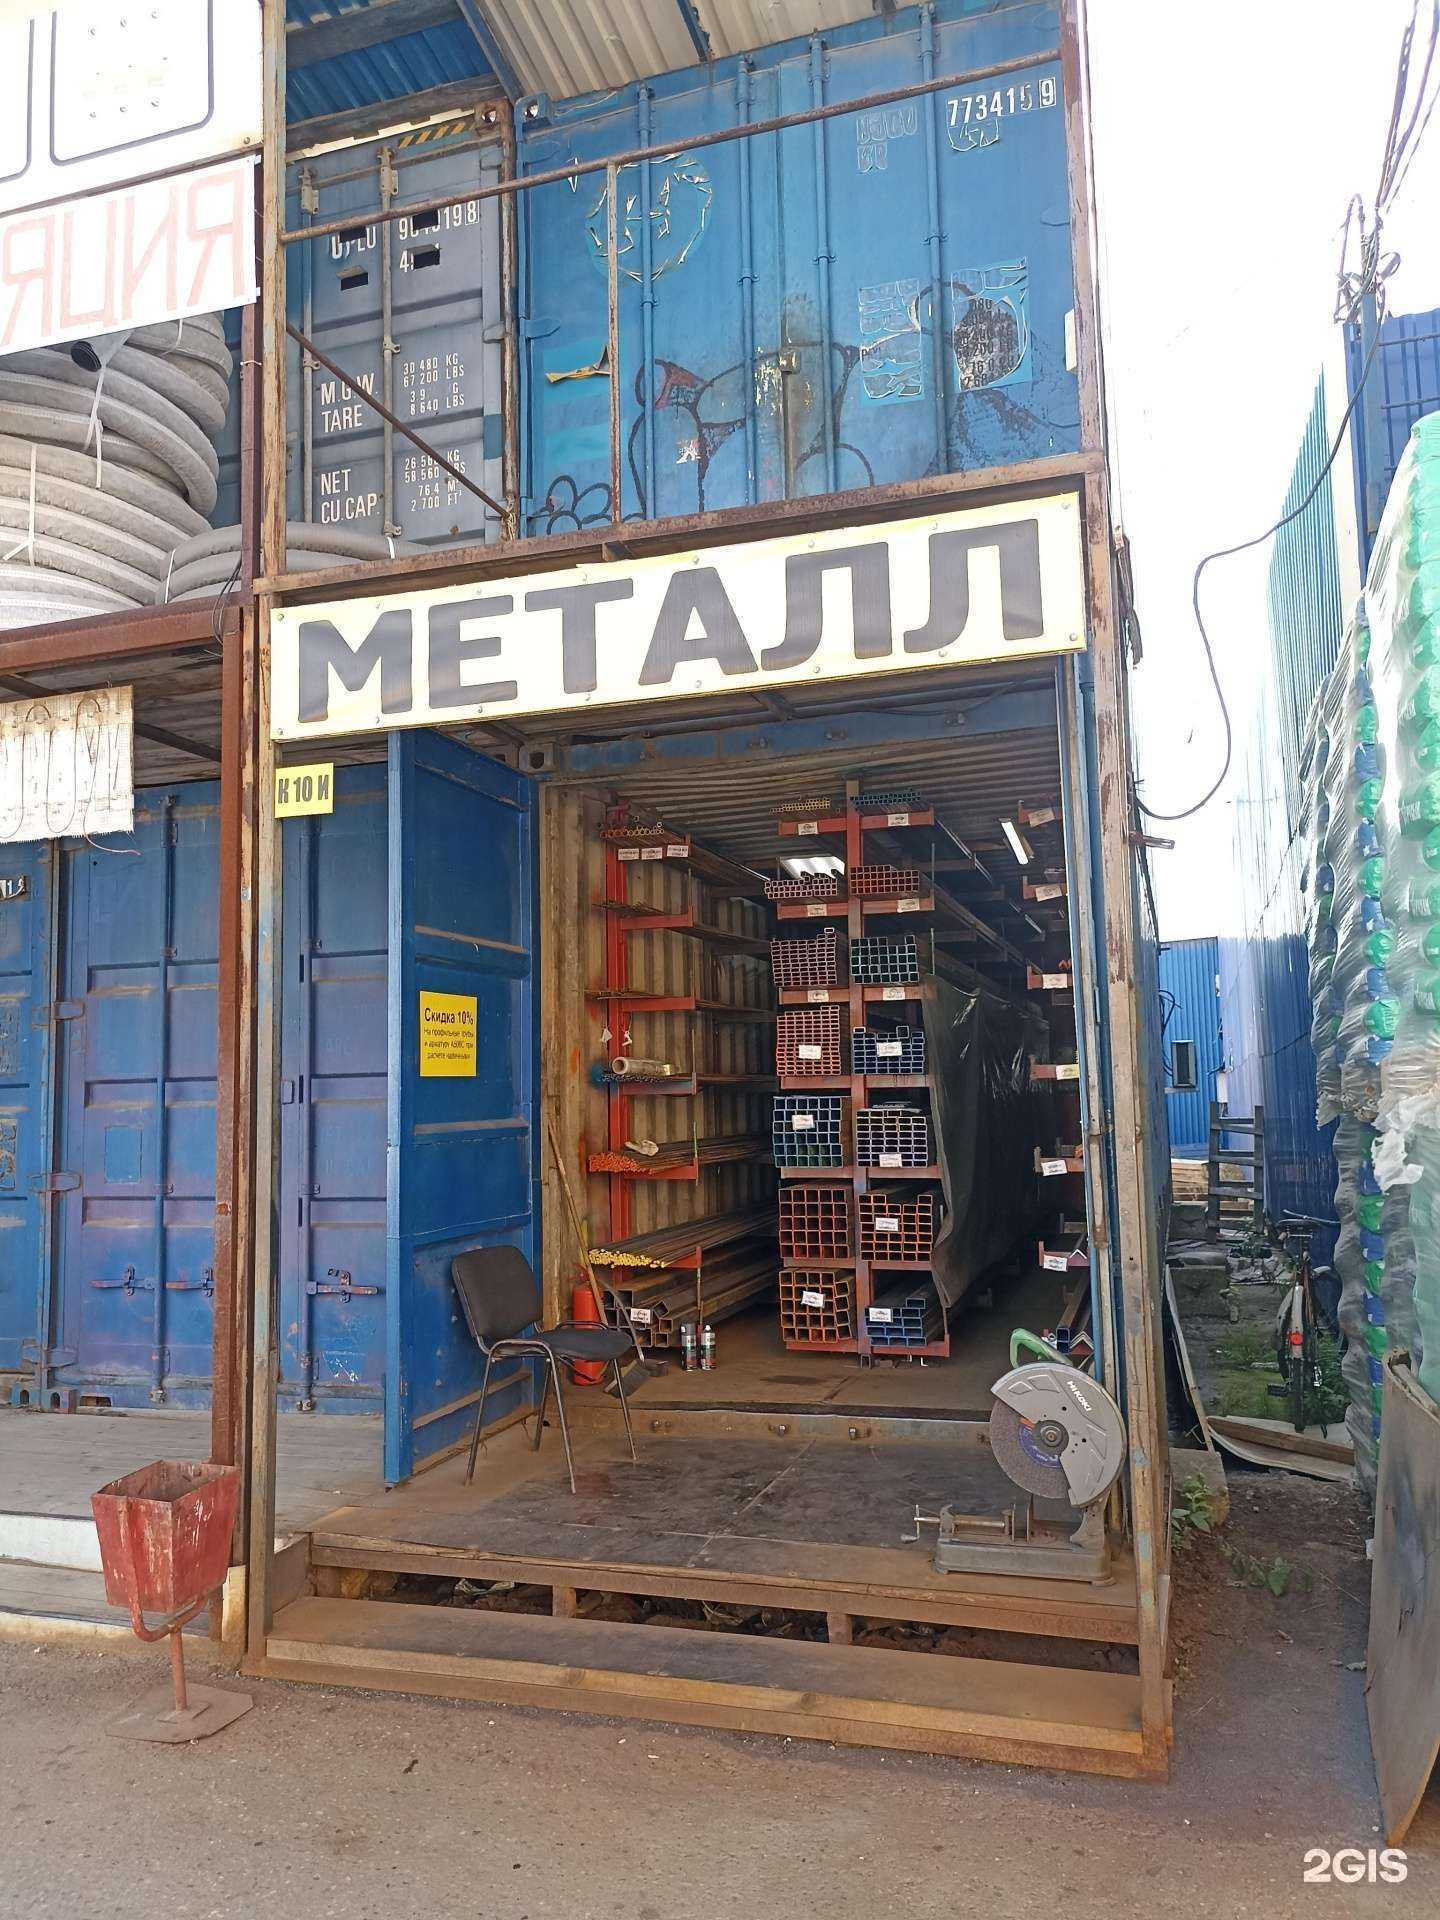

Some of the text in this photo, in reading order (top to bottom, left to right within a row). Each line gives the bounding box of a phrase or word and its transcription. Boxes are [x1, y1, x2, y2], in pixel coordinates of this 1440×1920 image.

[446, 353, 458, 366] KG
[446, 364, 464, 380] LBS
[446, 394, 465, 409] LBS
[321, 404, 363, 433] TARE
[447, 449, 460, 464] KG
[321, 468, 351, 495] NET
[298, 518, 1045, 724] МЕТАЛЛ
[424, 1007, 474, 1025] Скидка 10%
